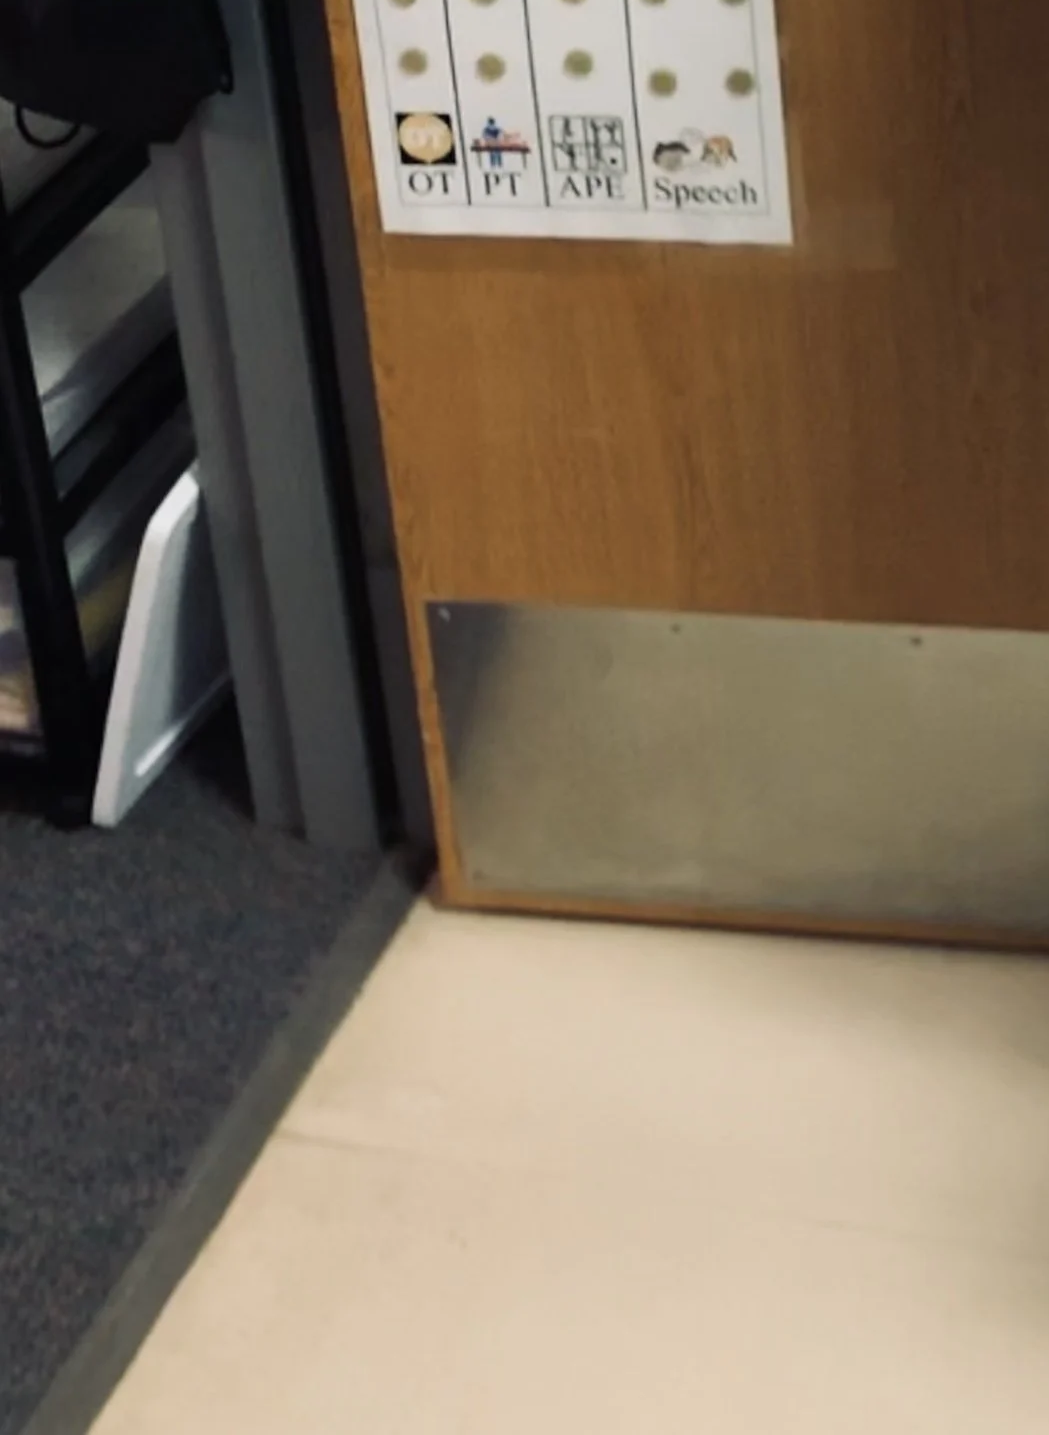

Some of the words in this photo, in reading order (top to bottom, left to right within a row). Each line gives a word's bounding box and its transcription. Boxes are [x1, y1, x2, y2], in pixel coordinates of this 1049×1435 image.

[408, 170, 454, 196] OT
[483, 171, 523, 197] PT
[560, 173, 624, 199] APE
[653, 176, 758, 210] Speech
